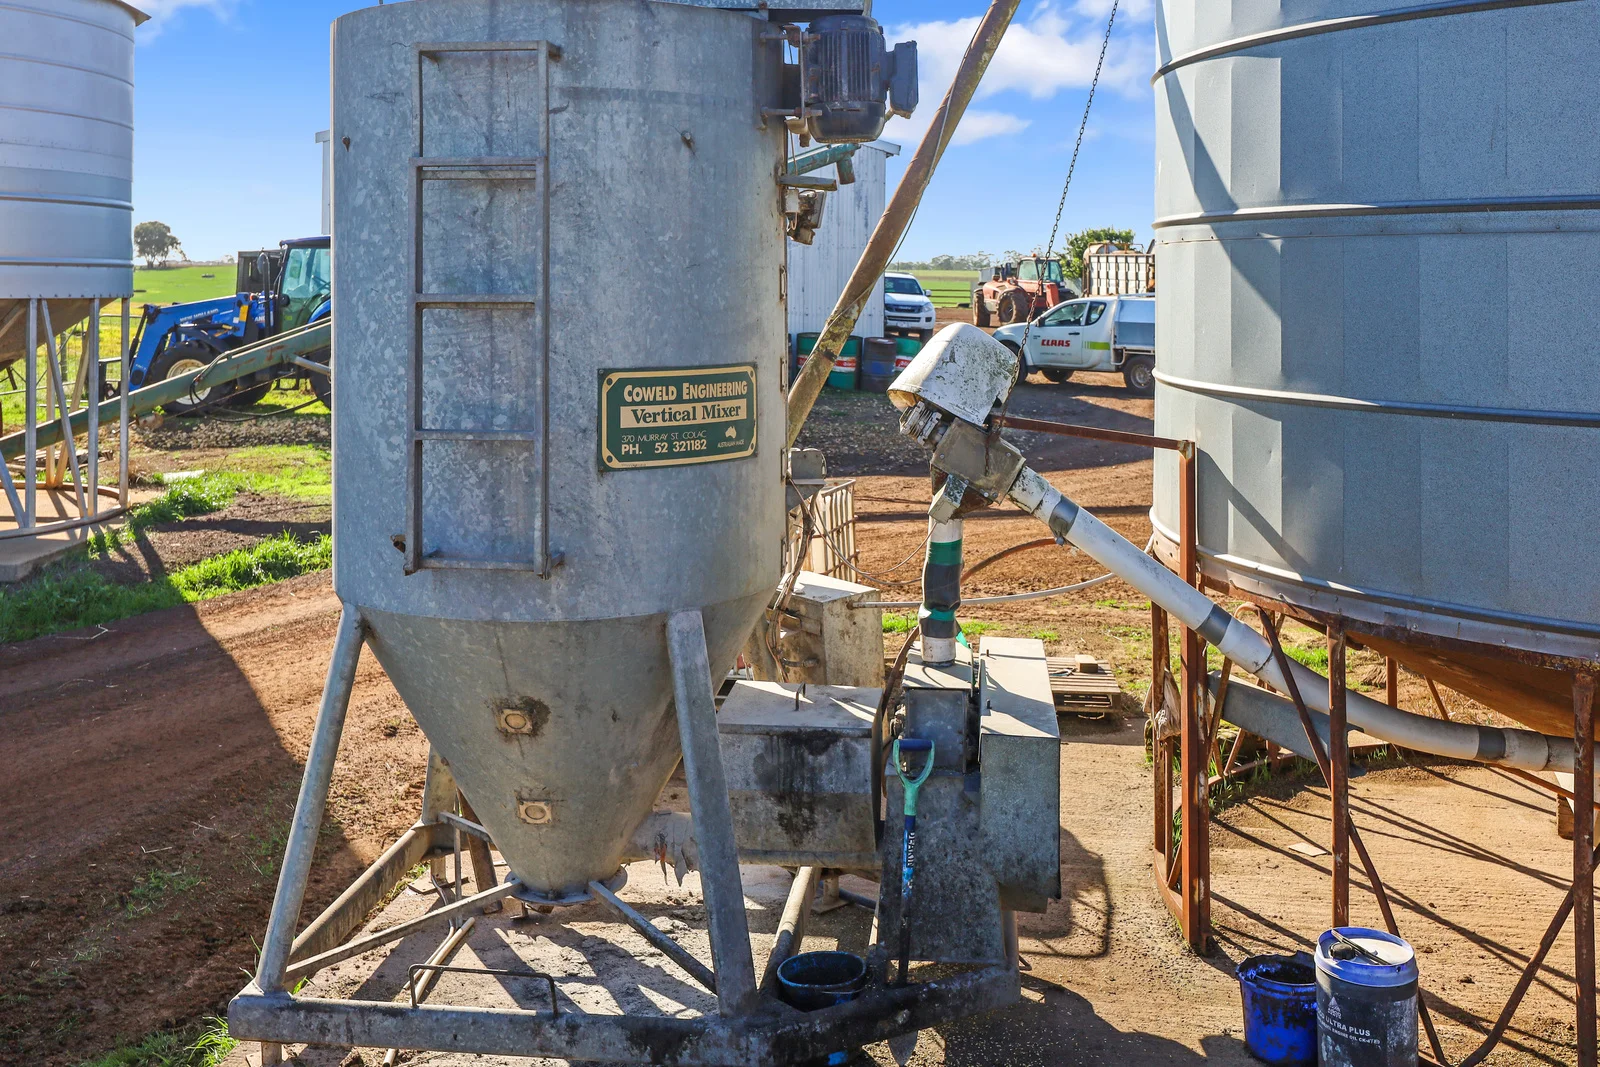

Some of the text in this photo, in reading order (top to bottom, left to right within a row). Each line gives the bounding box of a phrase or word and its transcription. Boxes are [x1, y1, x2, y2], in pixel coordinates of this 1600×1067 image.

[1041, 339, 1071, 347] CLAAS
[623, 380, 748, 403] COWELD ENGINEERING
[631, 403, 742, 424] Vertical Mixer
[622, 434, 635, 443] 370
[637, 432, 668, 442] MURRAY
[682, 430, 707, 440] COLAC
[621, 439, 707, 456] PH. 52 321182
[1325, 1015, 1347, 1032] ULTRA
[1348, 1026, 1371, 1037] PLUS
